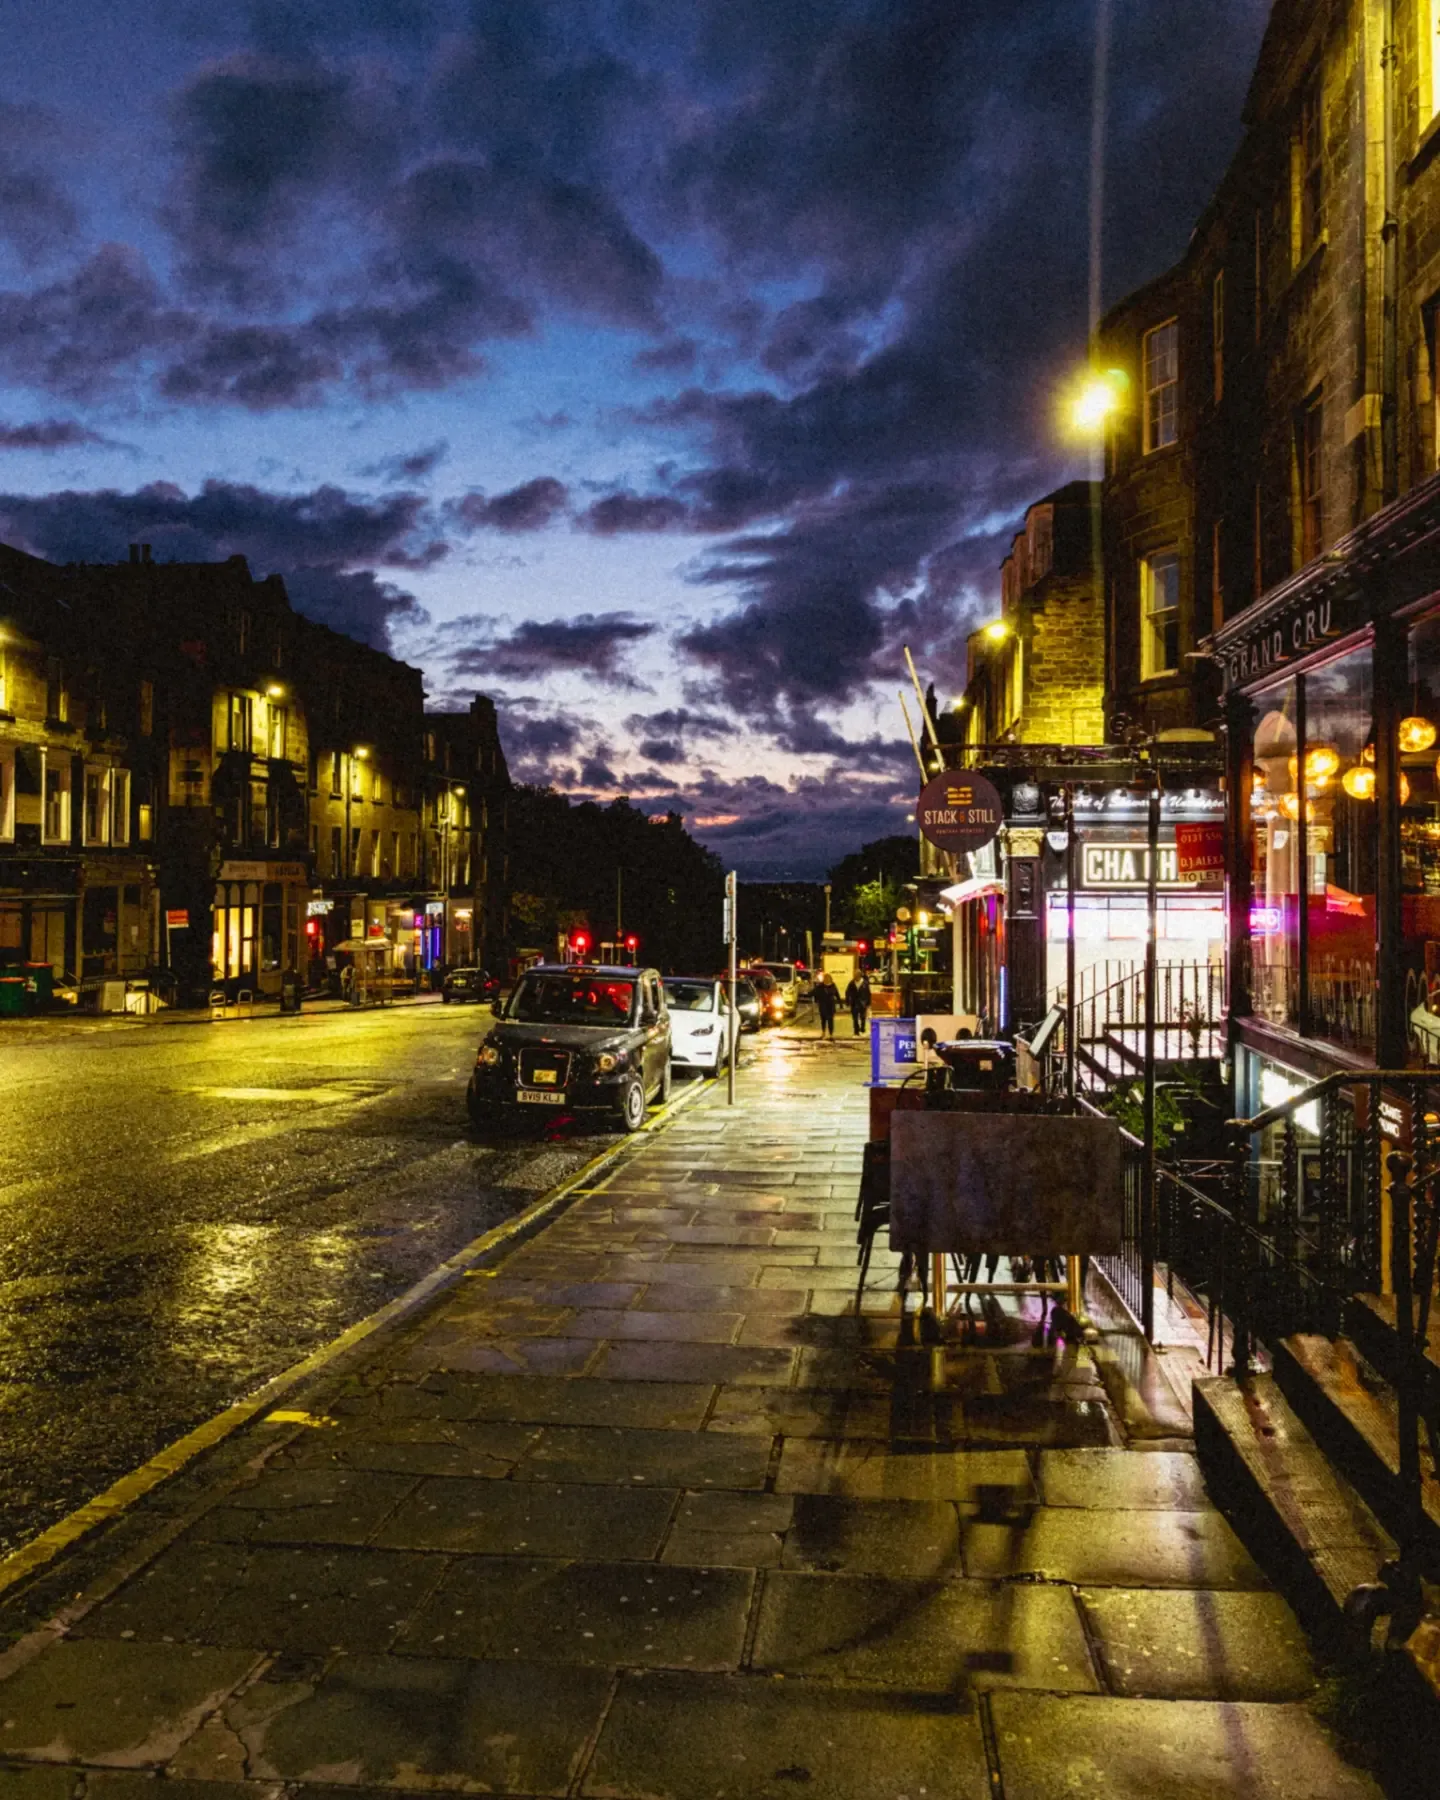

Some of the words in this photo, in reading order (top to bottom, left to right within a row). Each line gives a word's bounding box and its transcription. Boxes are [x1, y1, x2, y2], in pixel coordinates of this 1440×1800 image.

[1229, 630, 1283, 683] GRAND
[1292, 600, 1331, 649] CRU
[924, 810, 957, 825] STACK
[968, 808, 997, 824] STILL
[1180, 832, 1202, 844] 0131
[1088, 849, 1136, 881] CHA
[1183, 872, 1197, 882] TO
[1199, 871, 1219, 882] LET
[522, 1091, 541, 1102] BV19
[543, 1093, 561, 1103] KLJ
